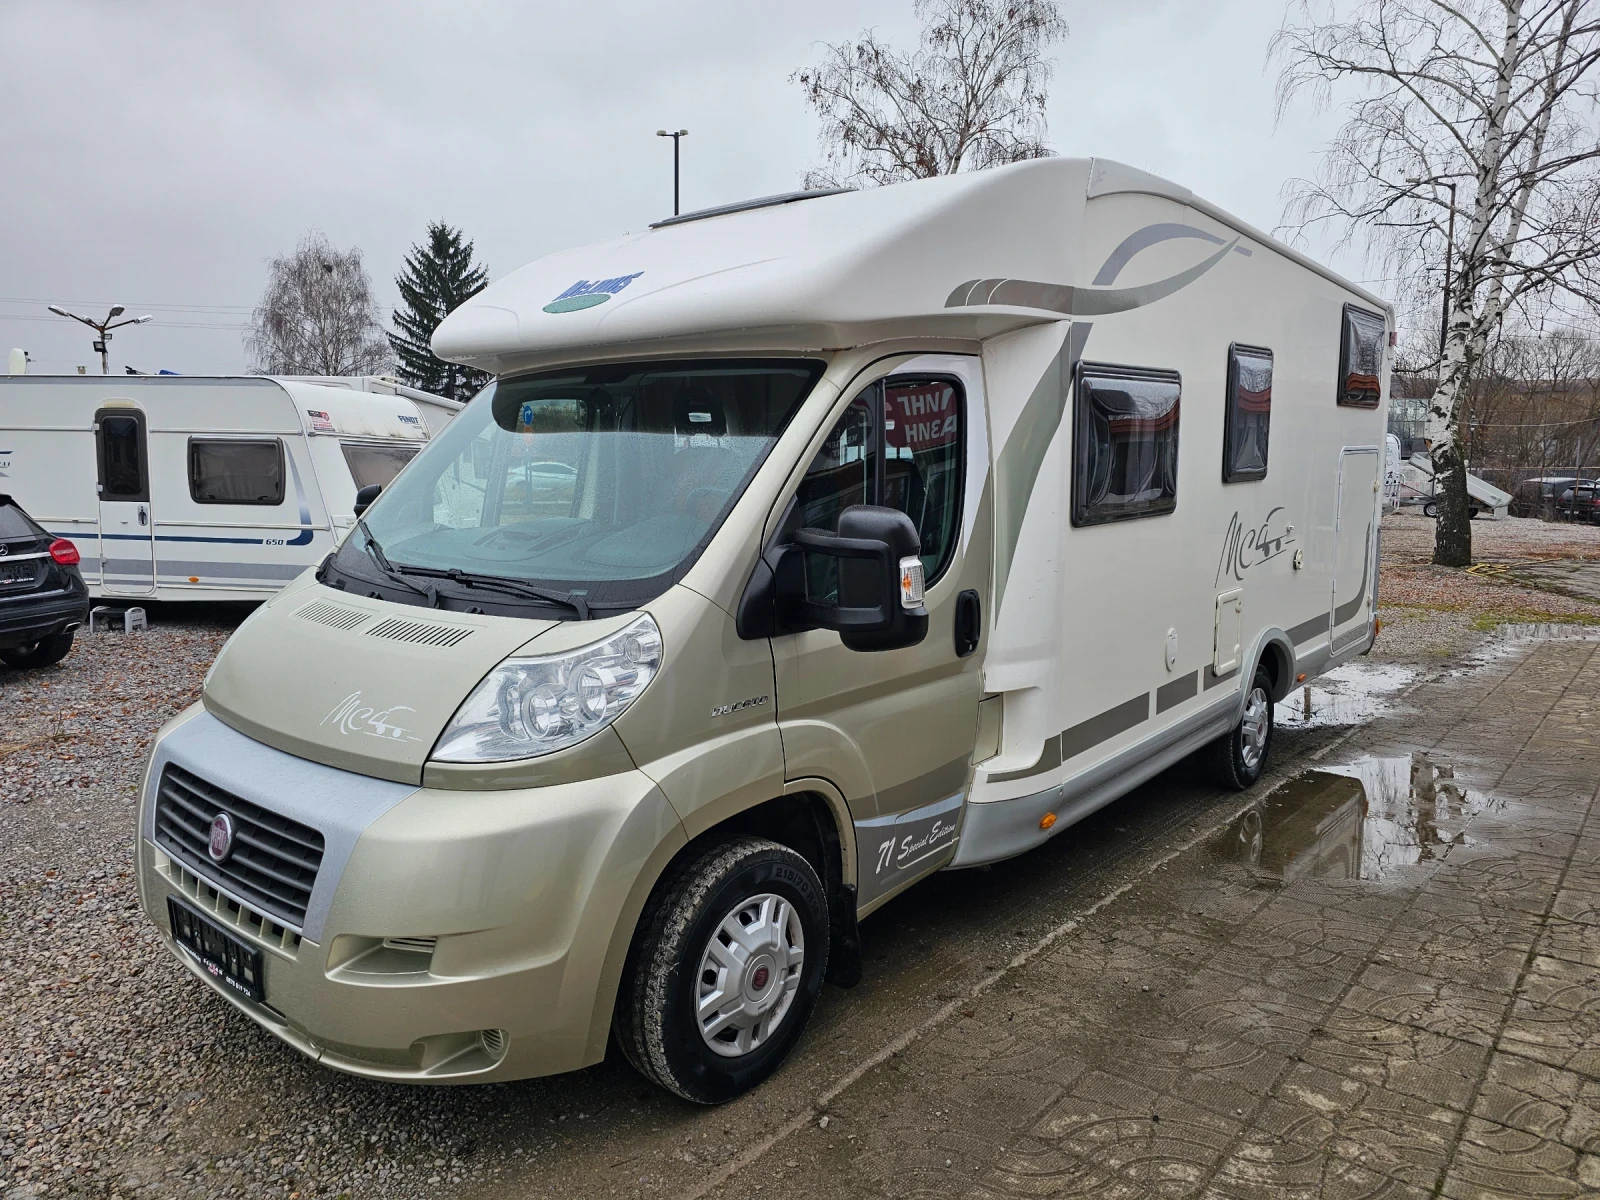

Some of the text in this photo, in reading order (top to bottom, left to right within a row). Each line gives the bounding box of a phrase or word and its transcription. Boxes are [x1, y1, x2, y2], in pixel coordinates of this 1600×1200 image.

[397, 415, 419, 424] FENDT
[265, 538, 284, 546] 650
[711, 695, 769, 718] DUCATO
[897, 833, 929, 860] Special
[928, 820, 956, 845] Edition
[775, 867, 809, 893] 215/70
